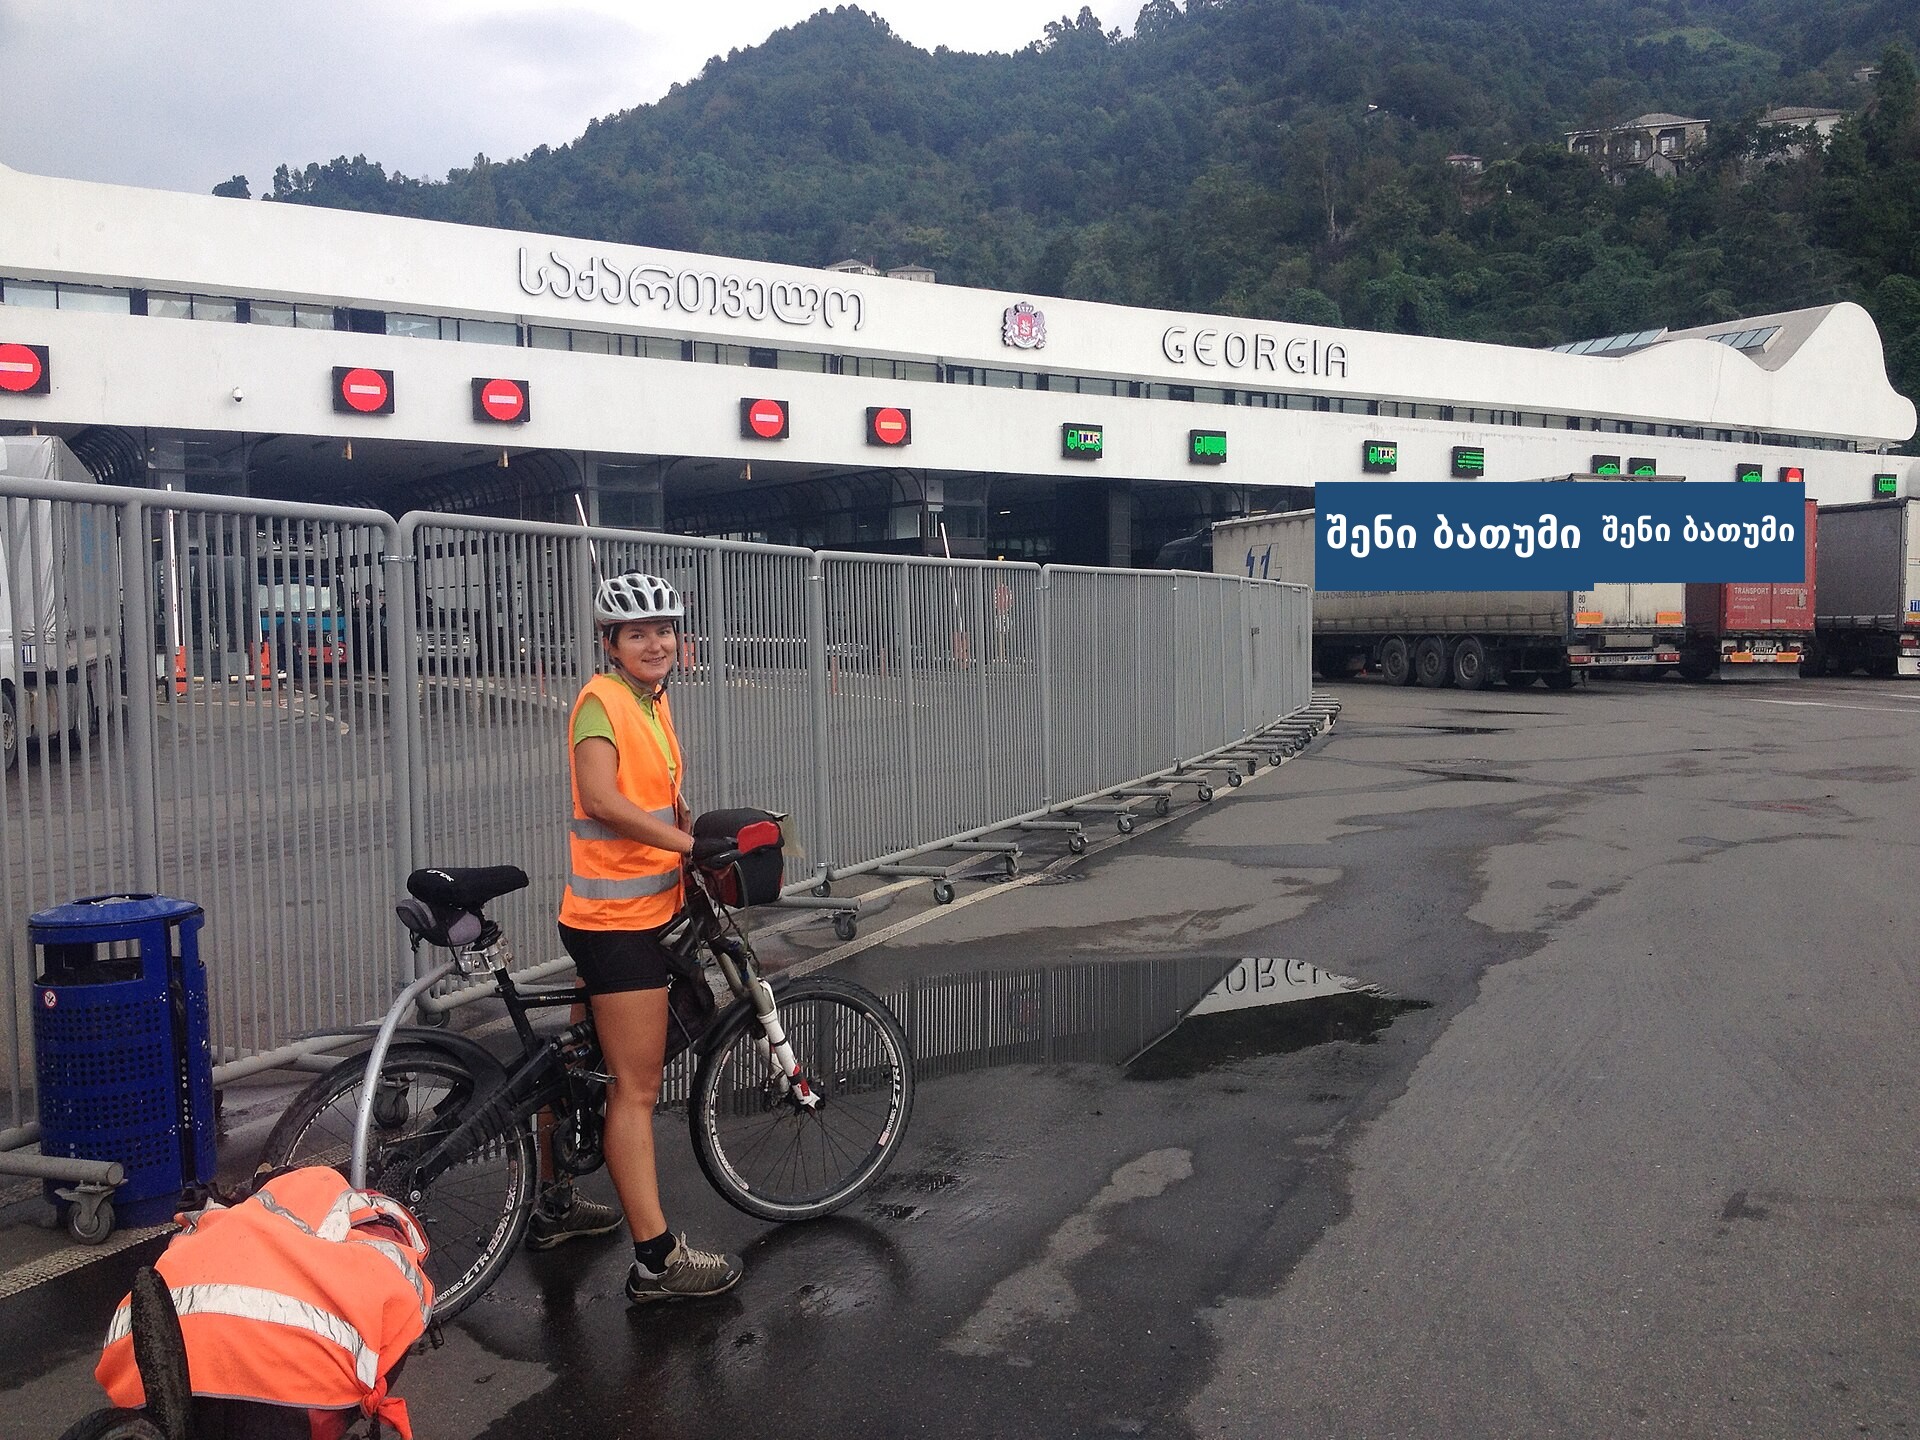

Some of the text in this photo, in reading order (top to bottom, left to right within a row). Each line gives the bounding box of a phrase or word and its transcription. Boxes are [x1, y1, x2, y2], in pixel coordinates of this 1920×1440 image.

[519, 247, 866, 331] საქართველო
[1162, 326, 1349, 378] GEORGIA
[1078, 430, 1100, 445] TIR
[1377, 446, 1396, 459] TIR
[1734, 586, 1769, 595] TRANSPORT
[1578, 594, 1586, 604] 80
[462, 1252, 489, 1285] ZTR
